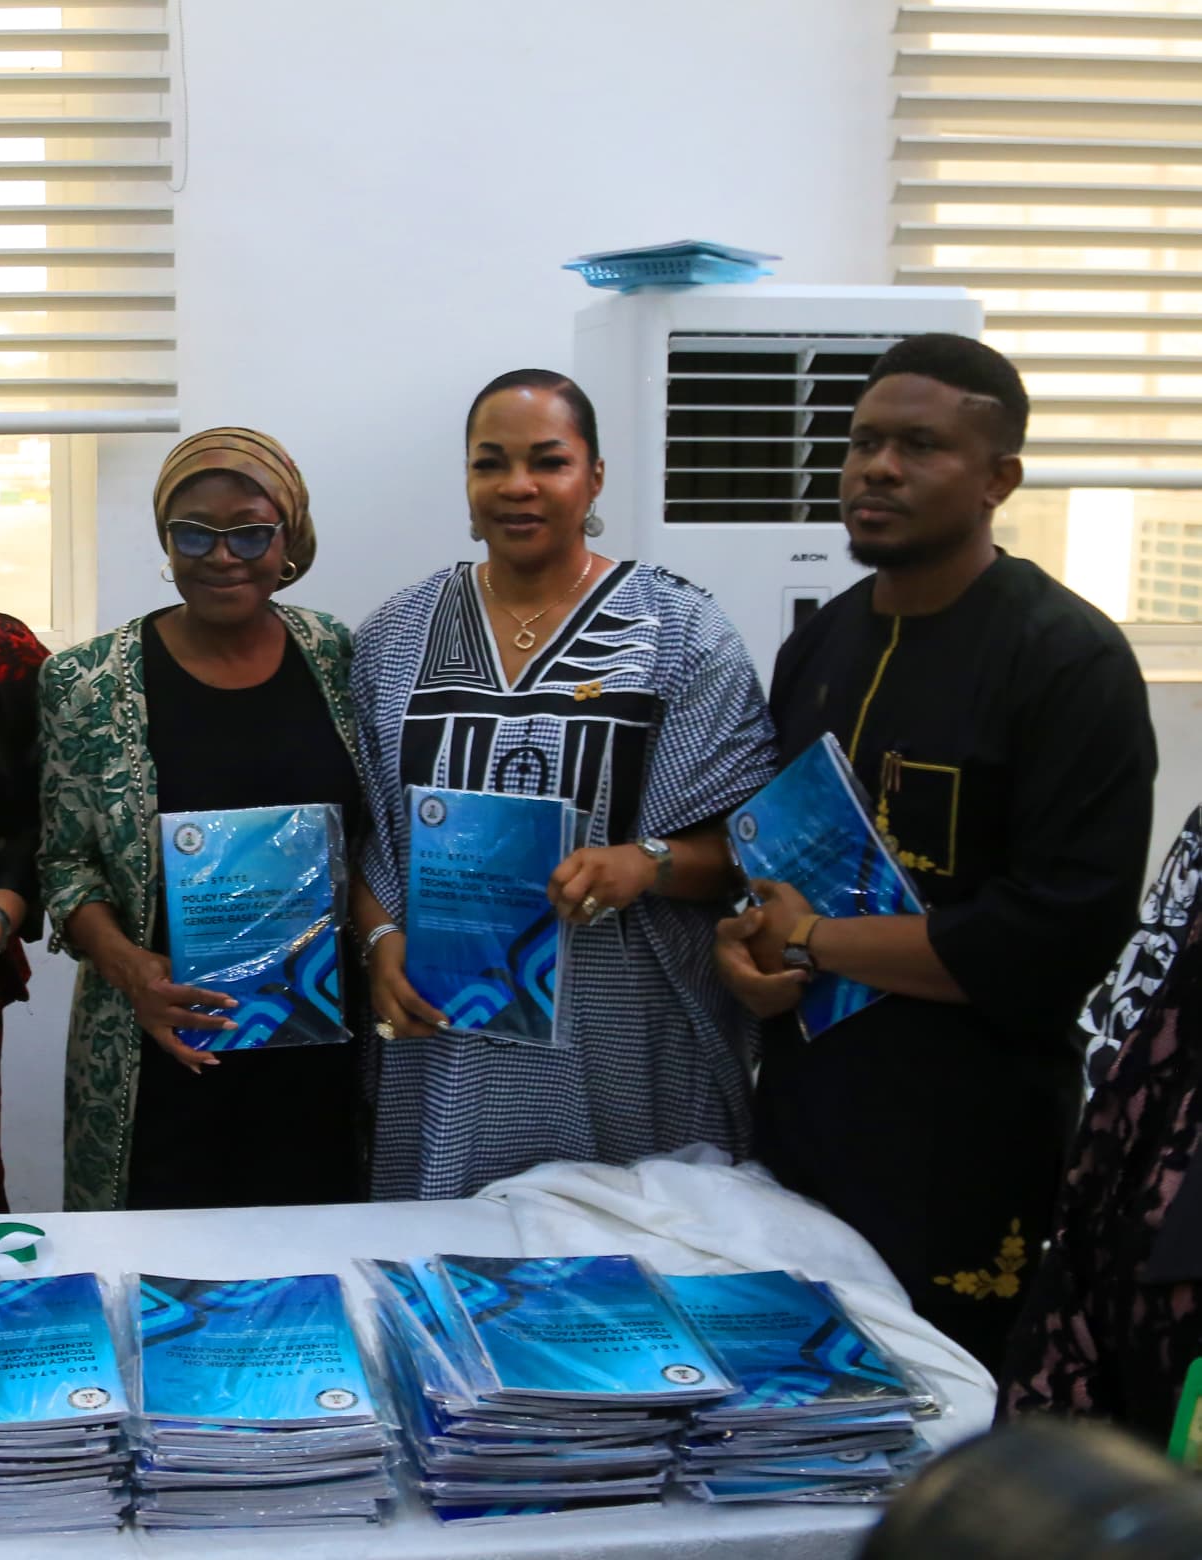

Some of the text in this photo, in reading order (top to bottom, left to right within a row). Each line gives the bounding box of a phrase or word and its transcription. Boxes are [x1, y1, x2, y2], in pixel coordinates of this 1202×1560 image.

[790, 553, 828, 562] AEON
[182, 894, 217, 903] POLICY
[48, 1355, 95, 1365] POLICY
[8, 1366, 99, 1380] EDO STATE
